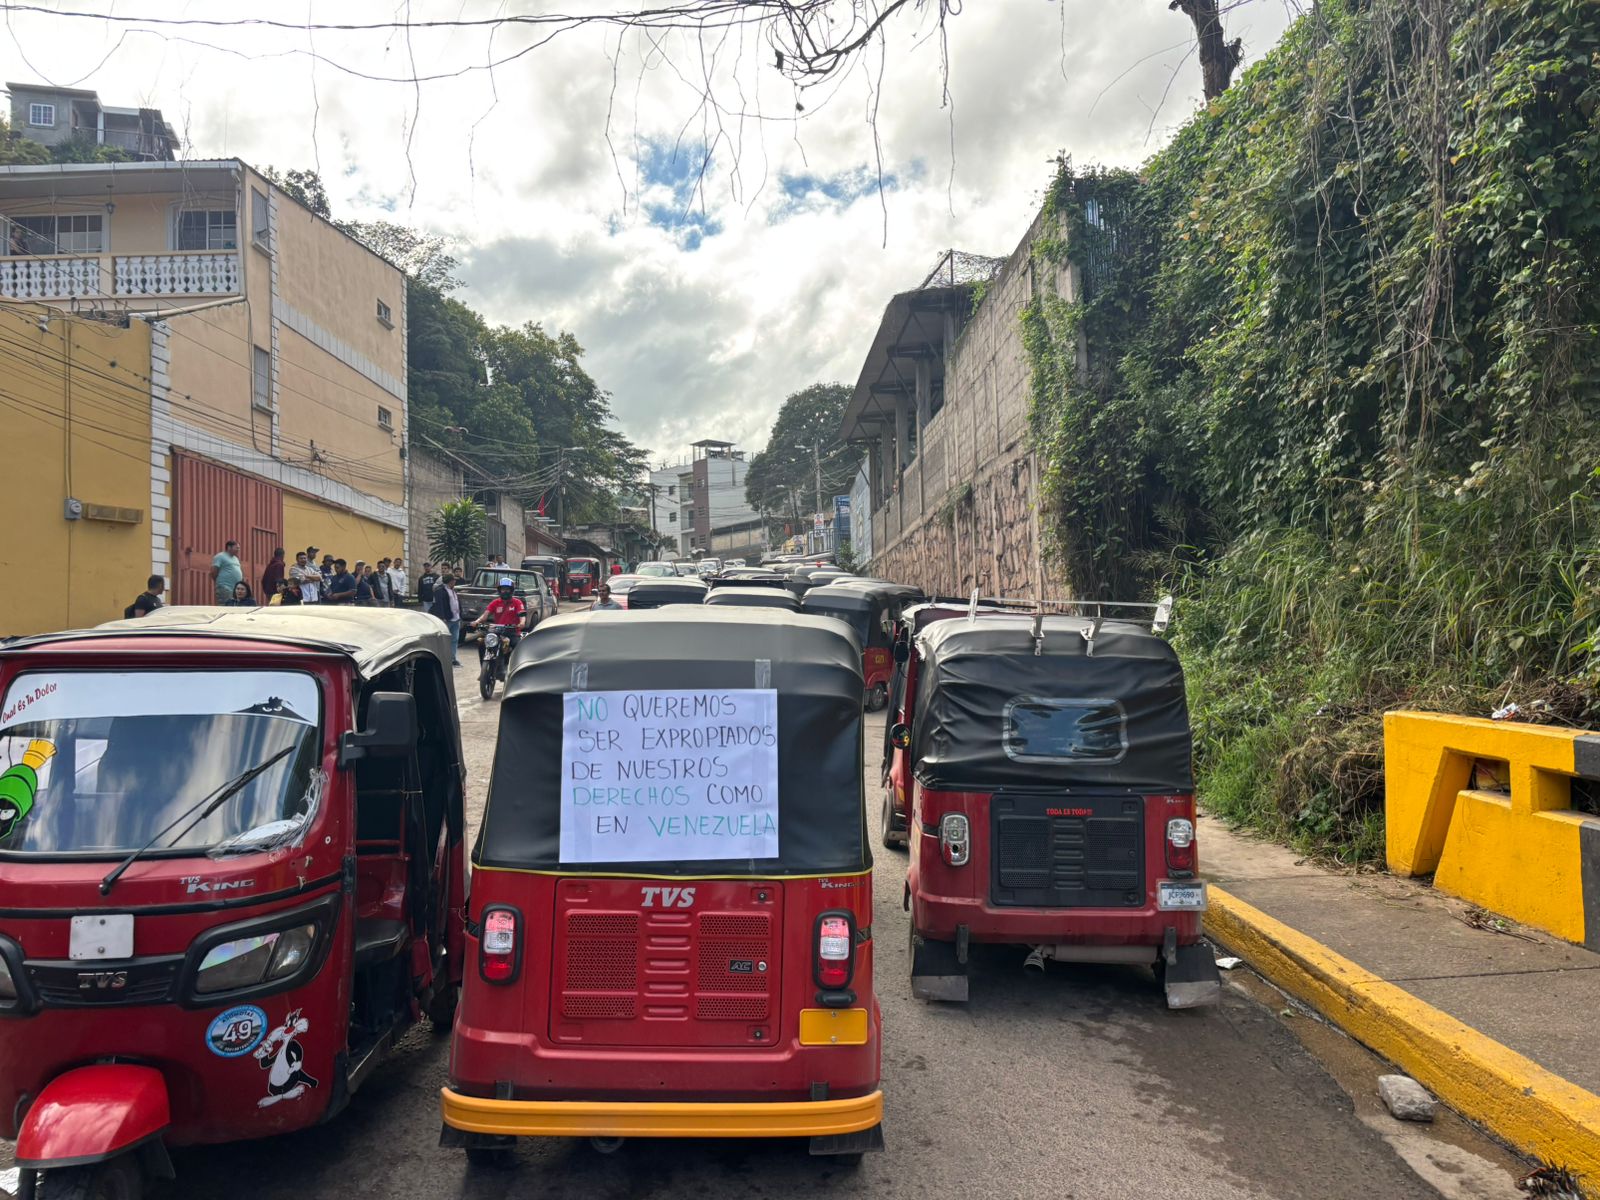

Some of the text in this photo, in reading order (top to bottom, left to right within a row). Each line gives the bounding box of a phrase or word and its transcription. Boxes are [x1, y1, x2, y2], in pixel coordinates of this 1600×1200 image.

[34, 683, 57, 700] Dolor
[577, 694, 737, 721] NO QUEREMOS
[578, 725, 777, 752] SER EXPROPIADOS
[571, 755, 729, 780] DE NUESTROS
[572, 783, 763, 807] DERECHOS COMO
[596, 812, 777, 838] EN VENEZUELA
[180, 876, 201, 885] TVS
[186, 879, 255, 893] KING
[640, 886, 697, 908] TVS
[78, 971, 128, 989] TVS
[223, 1020, 252, 1042] 49
